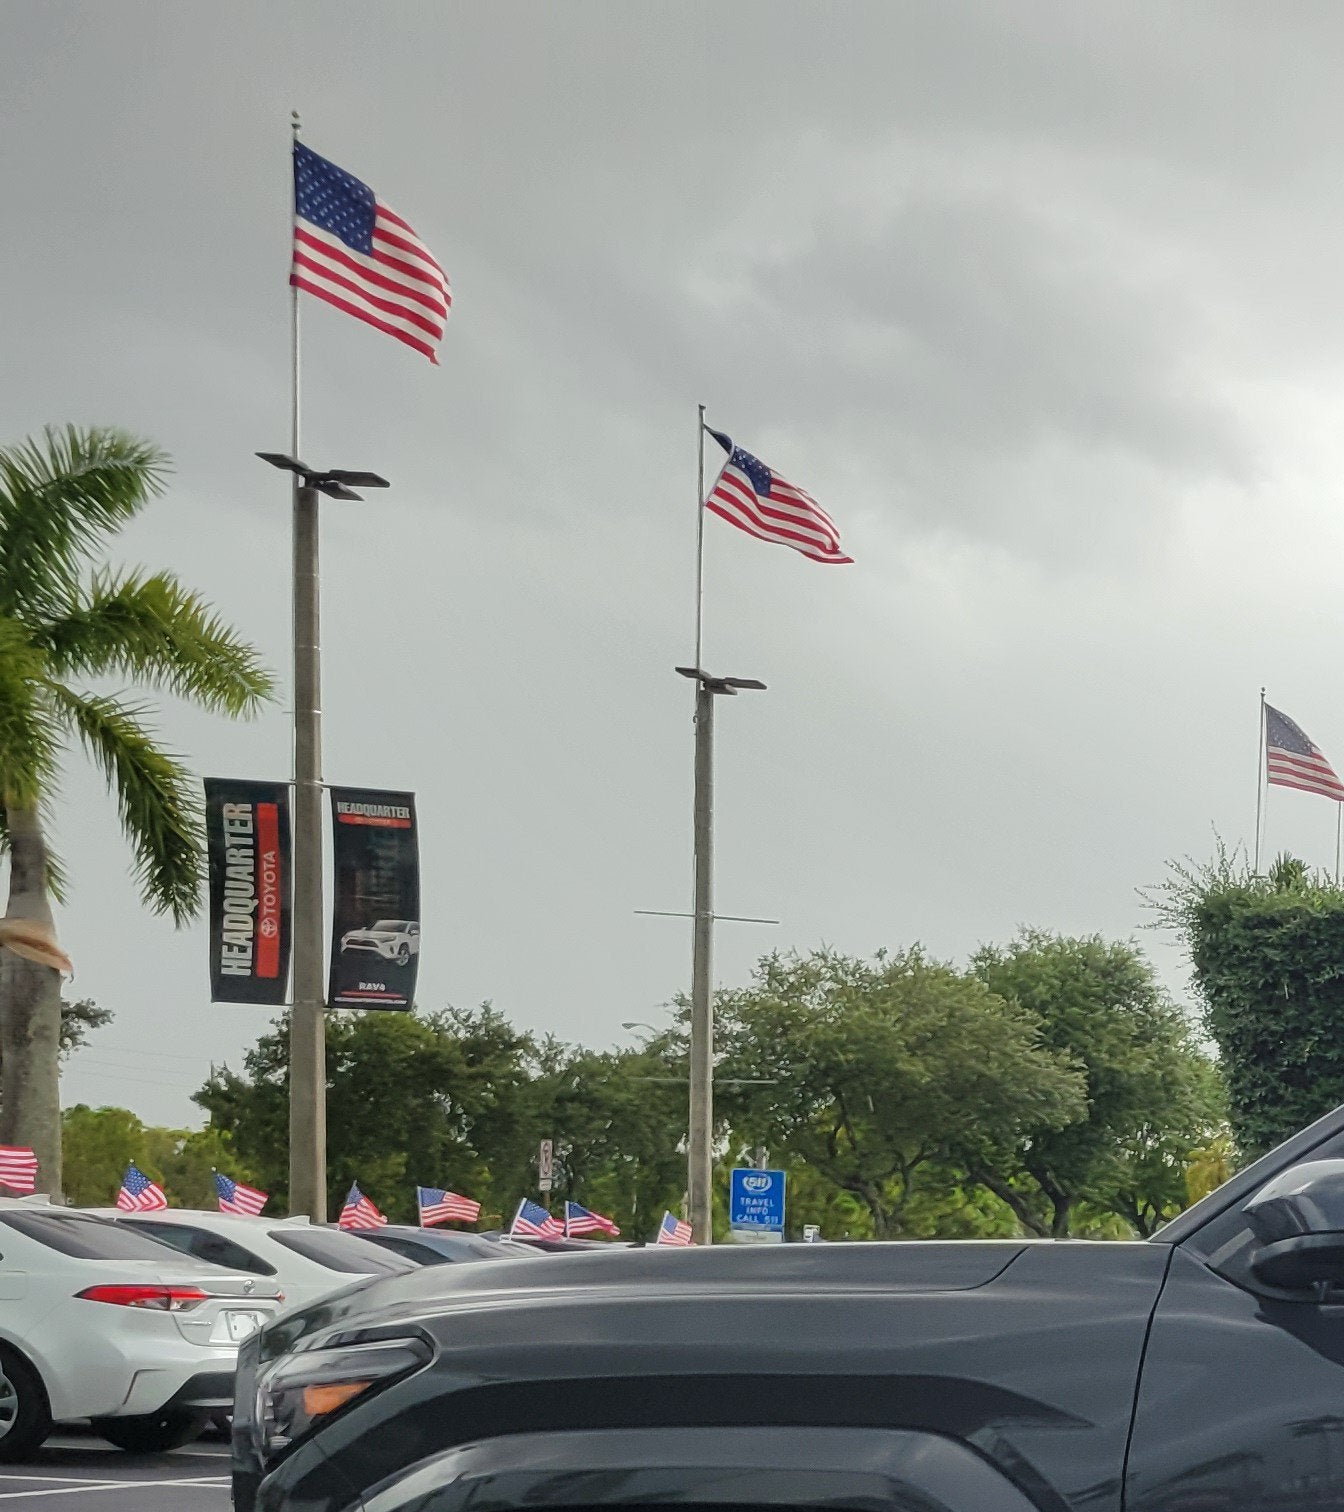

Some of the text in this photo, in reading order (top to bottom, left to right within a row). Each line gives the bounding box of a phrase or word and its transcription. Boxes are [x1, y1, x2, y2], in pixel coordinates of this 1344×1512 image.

[337, 801, 410, 819] HEADQUARTER
[263, 851, 277, 916] TOYOTA
[221, 802, 259, 976] HEADQUARTER
[358, 981, 386, 991] RAV4
[740, 1197, 775, 1207] TRAVEL
[746, 1206, 768, 1215] INFO
[736, 1214, 760, 1223] CALL
